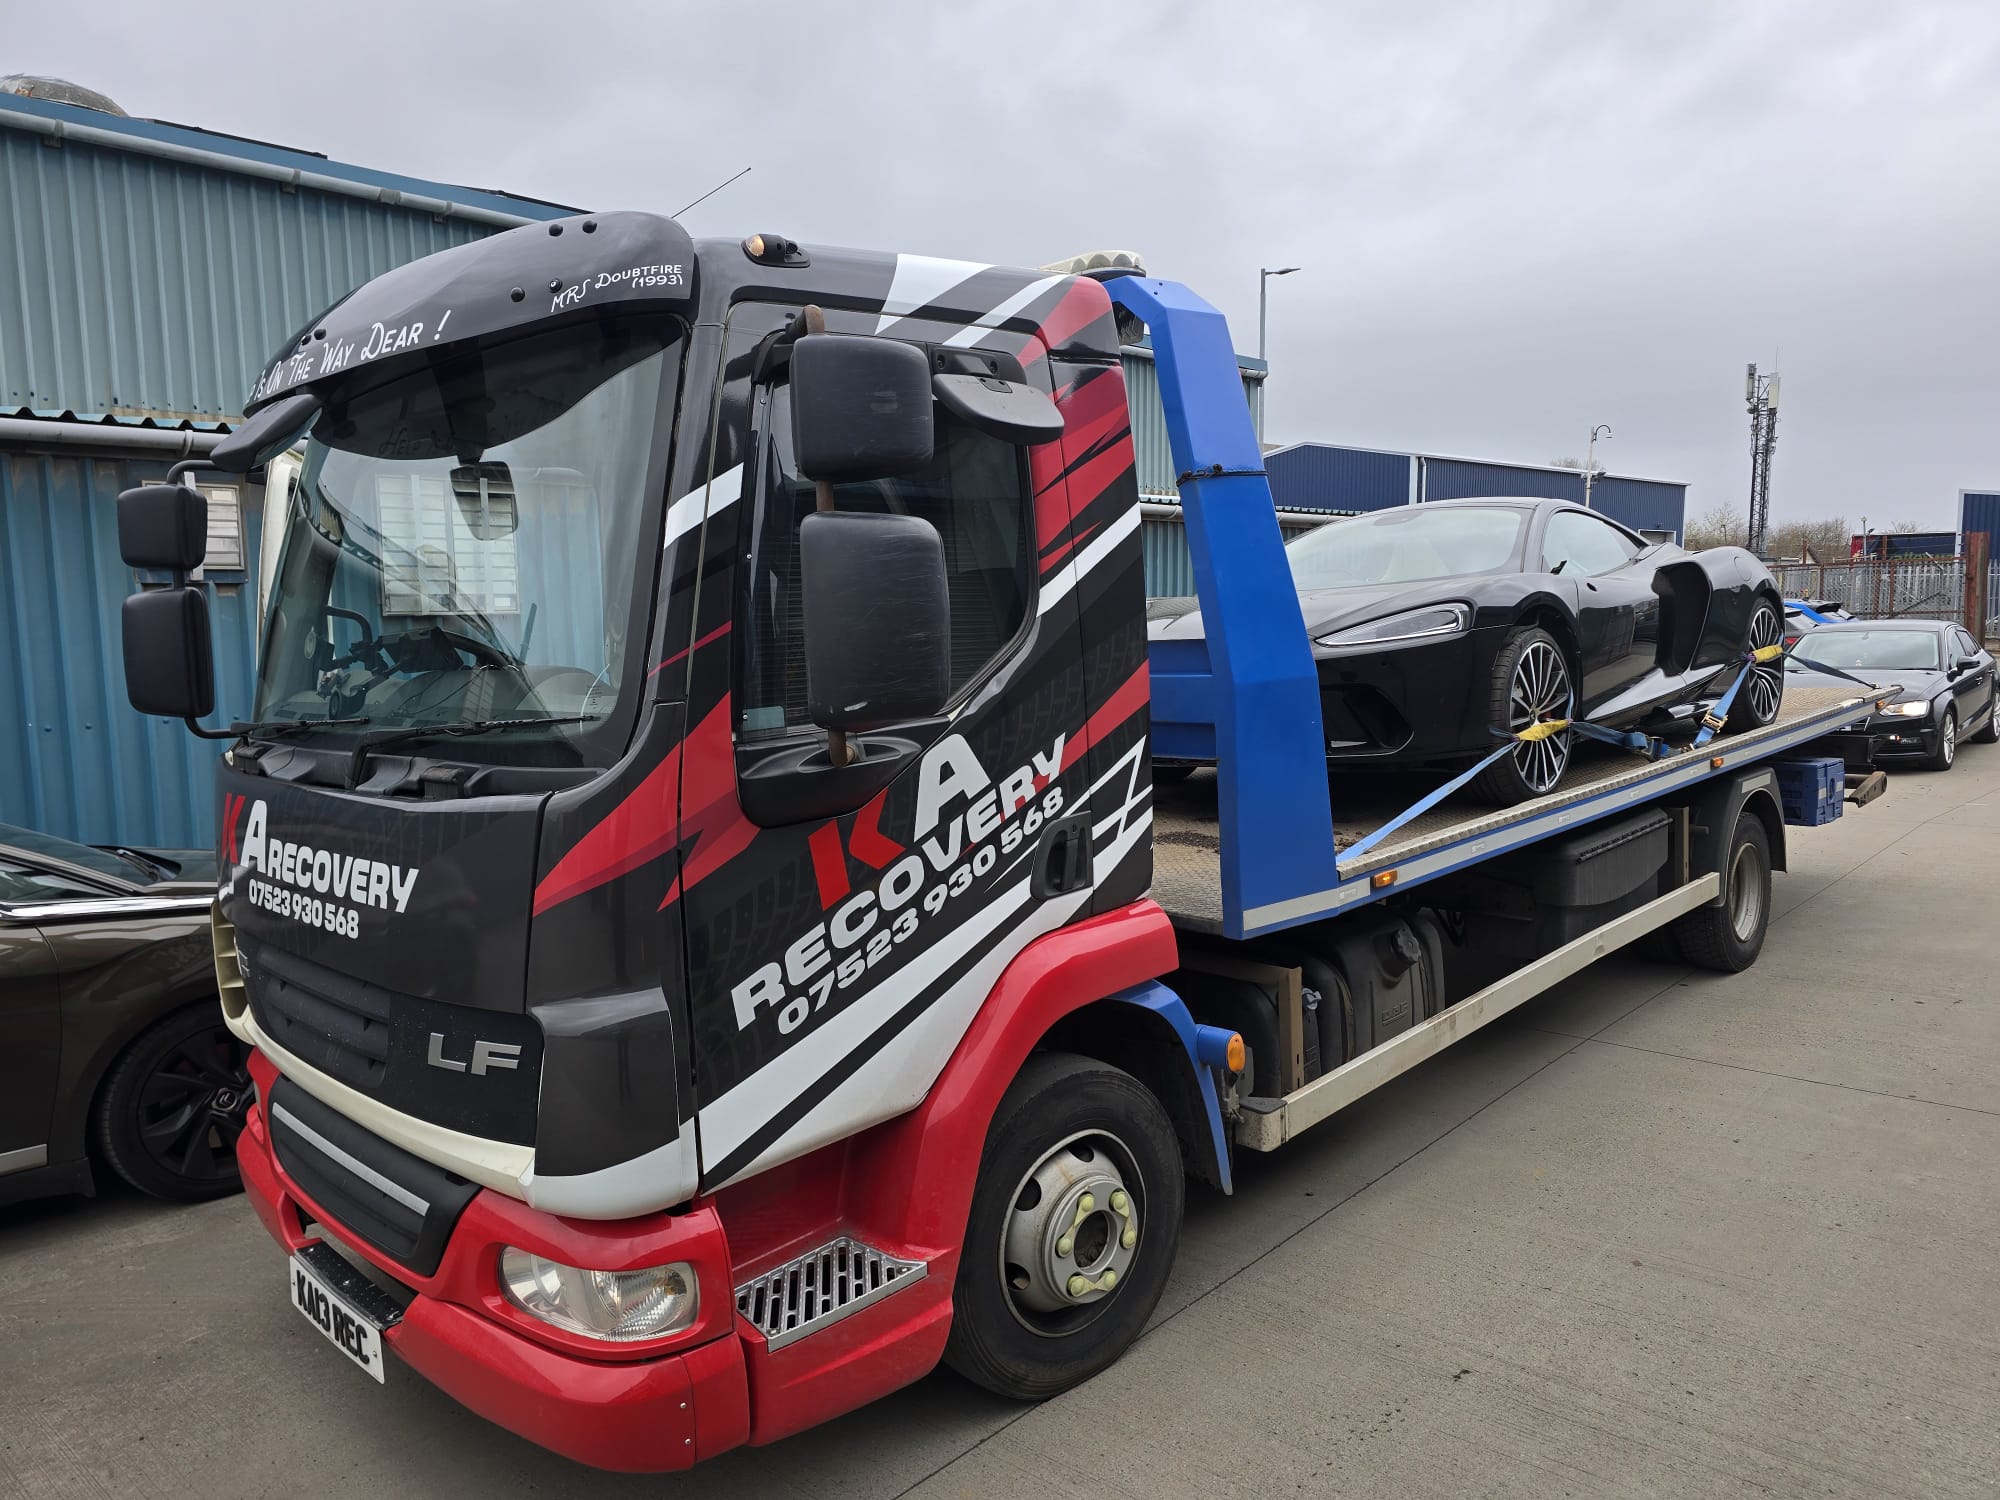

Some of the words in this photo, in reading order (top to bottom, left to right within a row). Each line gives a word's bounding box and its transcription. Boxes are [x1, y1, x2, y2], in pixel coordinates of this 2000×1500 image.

[550, 279, 591, 313] MRS
[594, 264, 683, 289] DOUBTFIRE
[631, 274, 683, 288] (1993)
[288, 352, 314, 386] THE
[319, 338, 355, 374] WAY
[361, 322, 424, 361] DEAR
[248, 878, 291, 917] 07523
[292, 893, 323, 928] 930
[324, 902, 359, 939] 568
[731, 733, 1066, 1032] RECOVERY
[777, 906, 920, 1036] 07523
[923, 845, 997, 917] 930
[1001, 787, 1065, 855] 568
[427, 1032, 522, 1076] LF
[296, 1269, 331, 1333] KA13
[332, 1303, 370, 1365] REC
